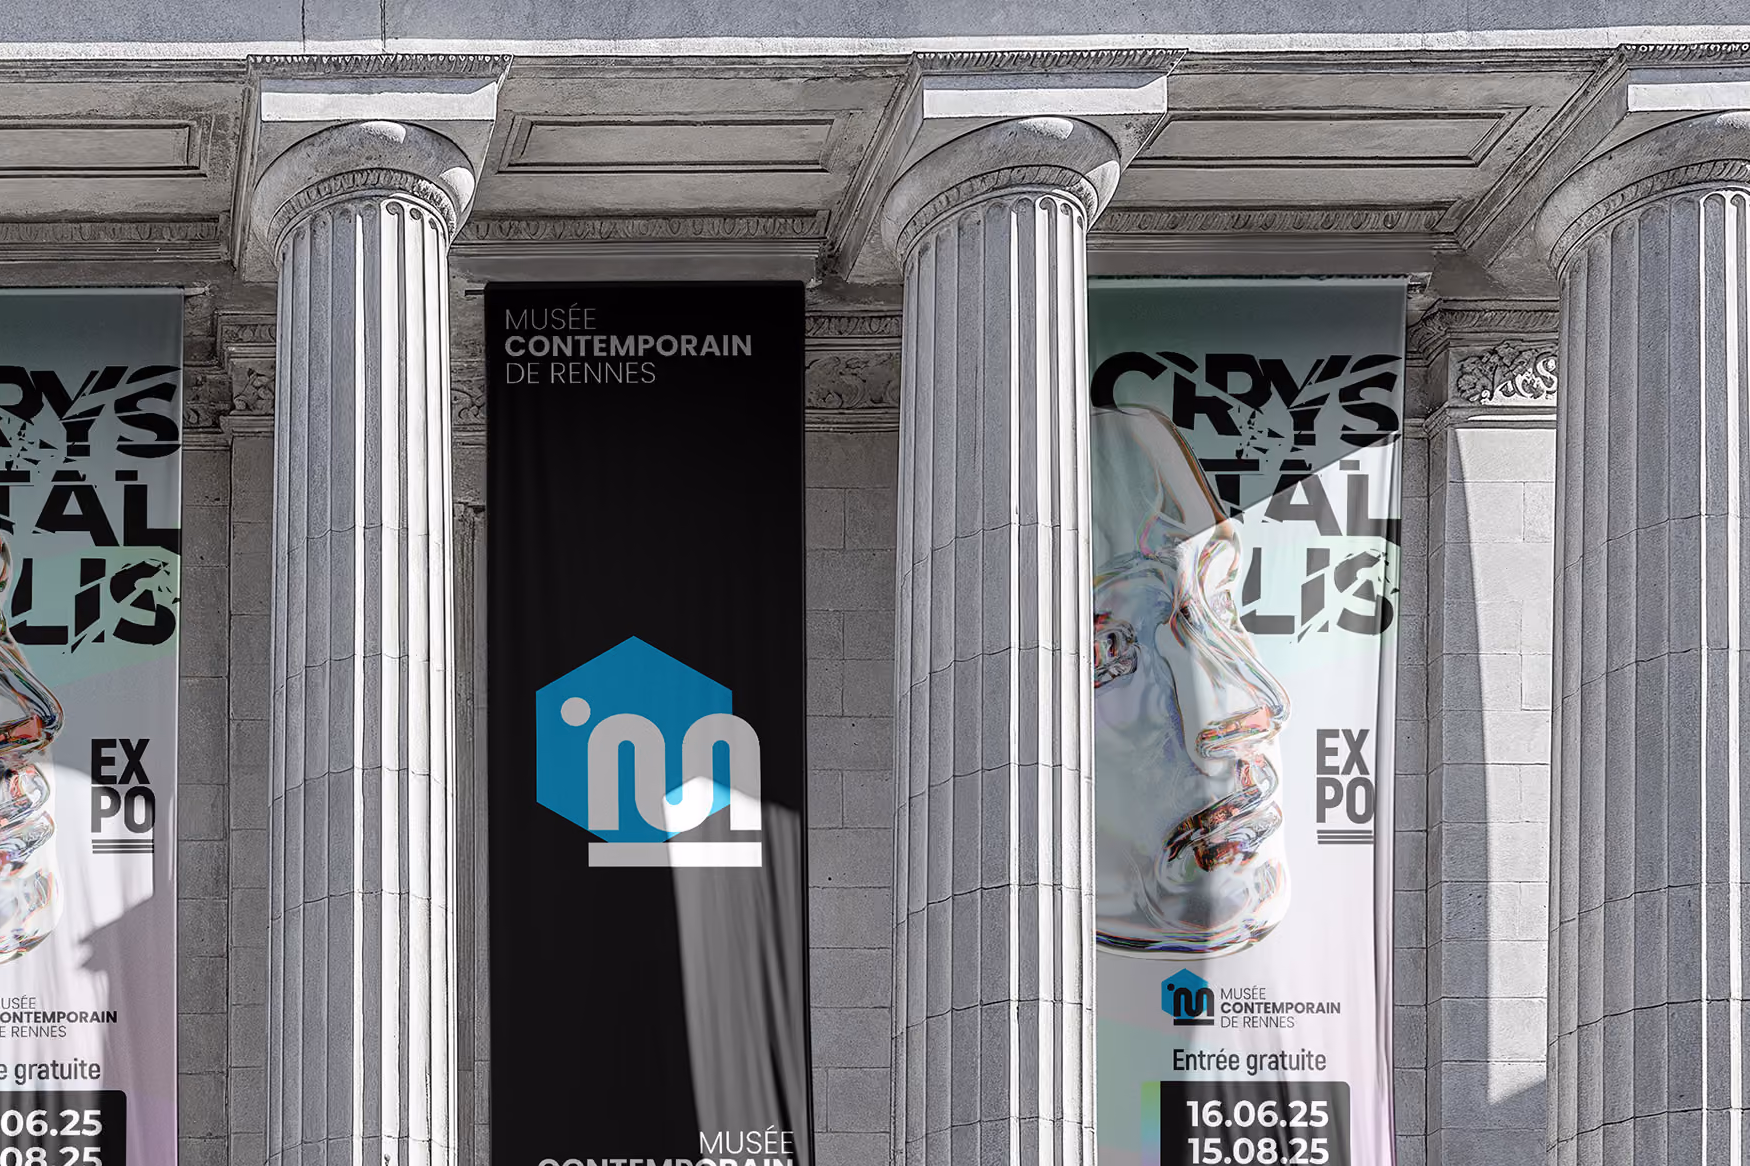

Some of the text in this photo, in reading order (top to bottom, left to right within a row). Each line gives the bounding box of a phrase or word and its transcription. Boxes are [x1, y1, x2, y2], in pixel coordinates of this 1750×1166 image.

[506, 302, 597, 330] MUSÉE
[504, 334, 752, 357] CONTEMPORAIN
[506, 362, 656, 384] DE RENNES
[1198, 458, 1401, 546] TAL
[9, 557, 179, 650] LIS
[1240, 547, 1396, 640] LIS
[91, 738, 150, 785] EX
[1316, 728, 1370, 775] EX
[91, 785, 156, 834] PO
[1316, 777, 1375, 824] PO
[1220, 985, 1266, 1000] MUSÉE
[1220, 1002, 1341, 1014] CONTEMPORAIN
[1220, 1016, 1295, 1028] DE RENNES
[11, 1025, 67, 1038] RENNES
[14, 1058, 101, 1085] gratuite
[1173, 1048, 1327, 1075] Entrée gratuite
[1186, 1100, 1329, 1127] 16.06.25
[700, 1125, 794, 1154] MUSÉE
[1187, 1137, 1330, 1165] 15.08.25
